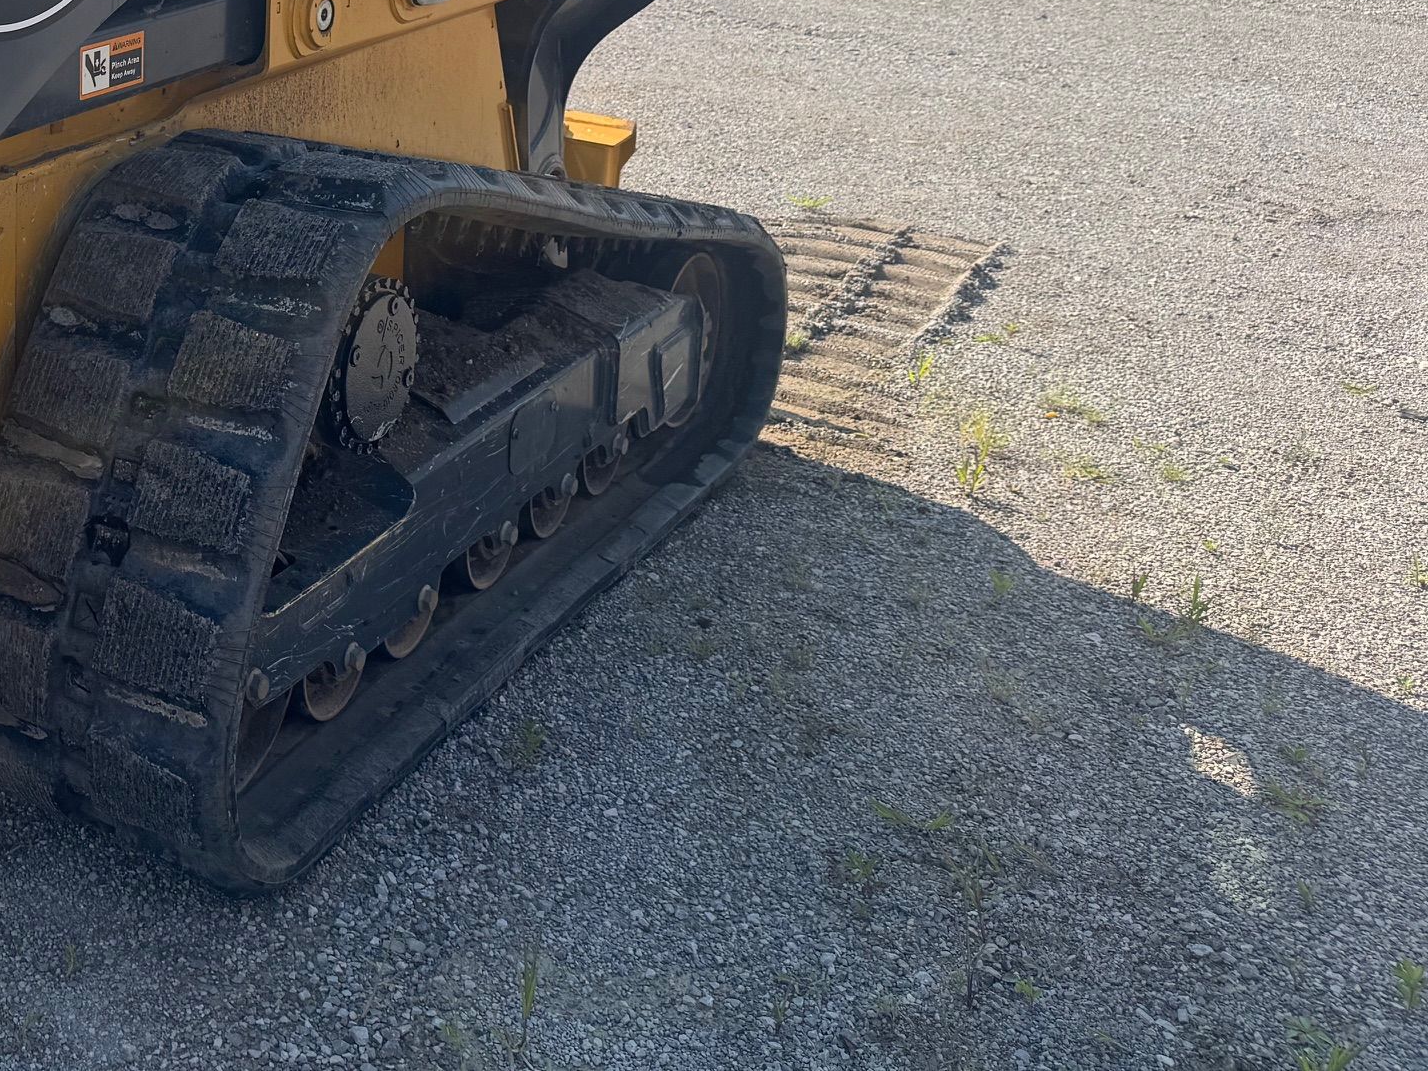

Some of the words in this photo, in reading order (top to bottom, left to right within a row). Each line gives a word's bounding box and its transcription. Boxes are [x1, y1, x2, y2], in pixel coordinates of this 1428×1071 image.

[111, 58, 127, 69] Pinch
[127, 56, 140, 65] Area
[111, 72, 123, 80] Keep
[123, 68, 136, 77] Away
